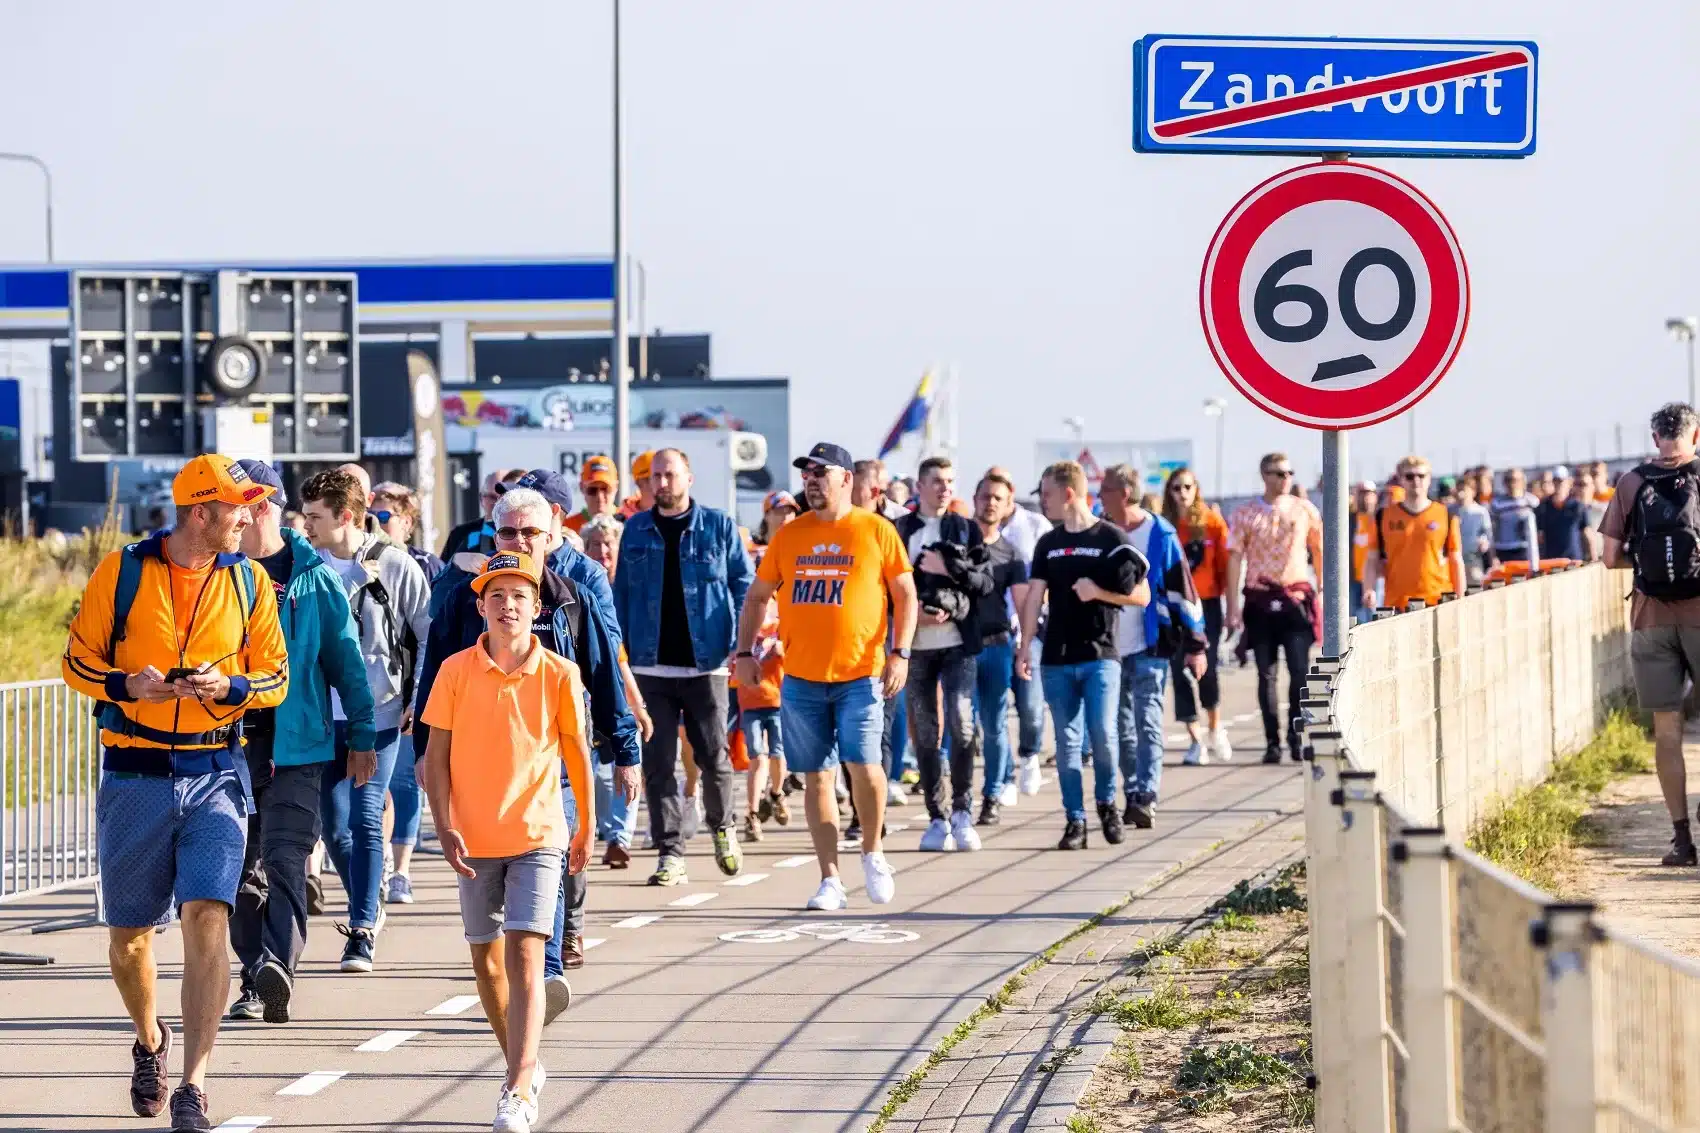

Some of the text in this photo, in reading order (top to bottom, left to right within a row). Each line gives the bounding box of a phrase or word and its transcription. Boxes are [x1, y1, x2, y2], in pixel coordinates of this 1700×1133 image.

[1179, 61, 1503, 116] Zandvoort
[1253, 246, 1417, 344] 60
[195, 486, 219, 497] exact
[792, 579, 845, 605] MAX
[531, 623, 551, 631] Mobil
